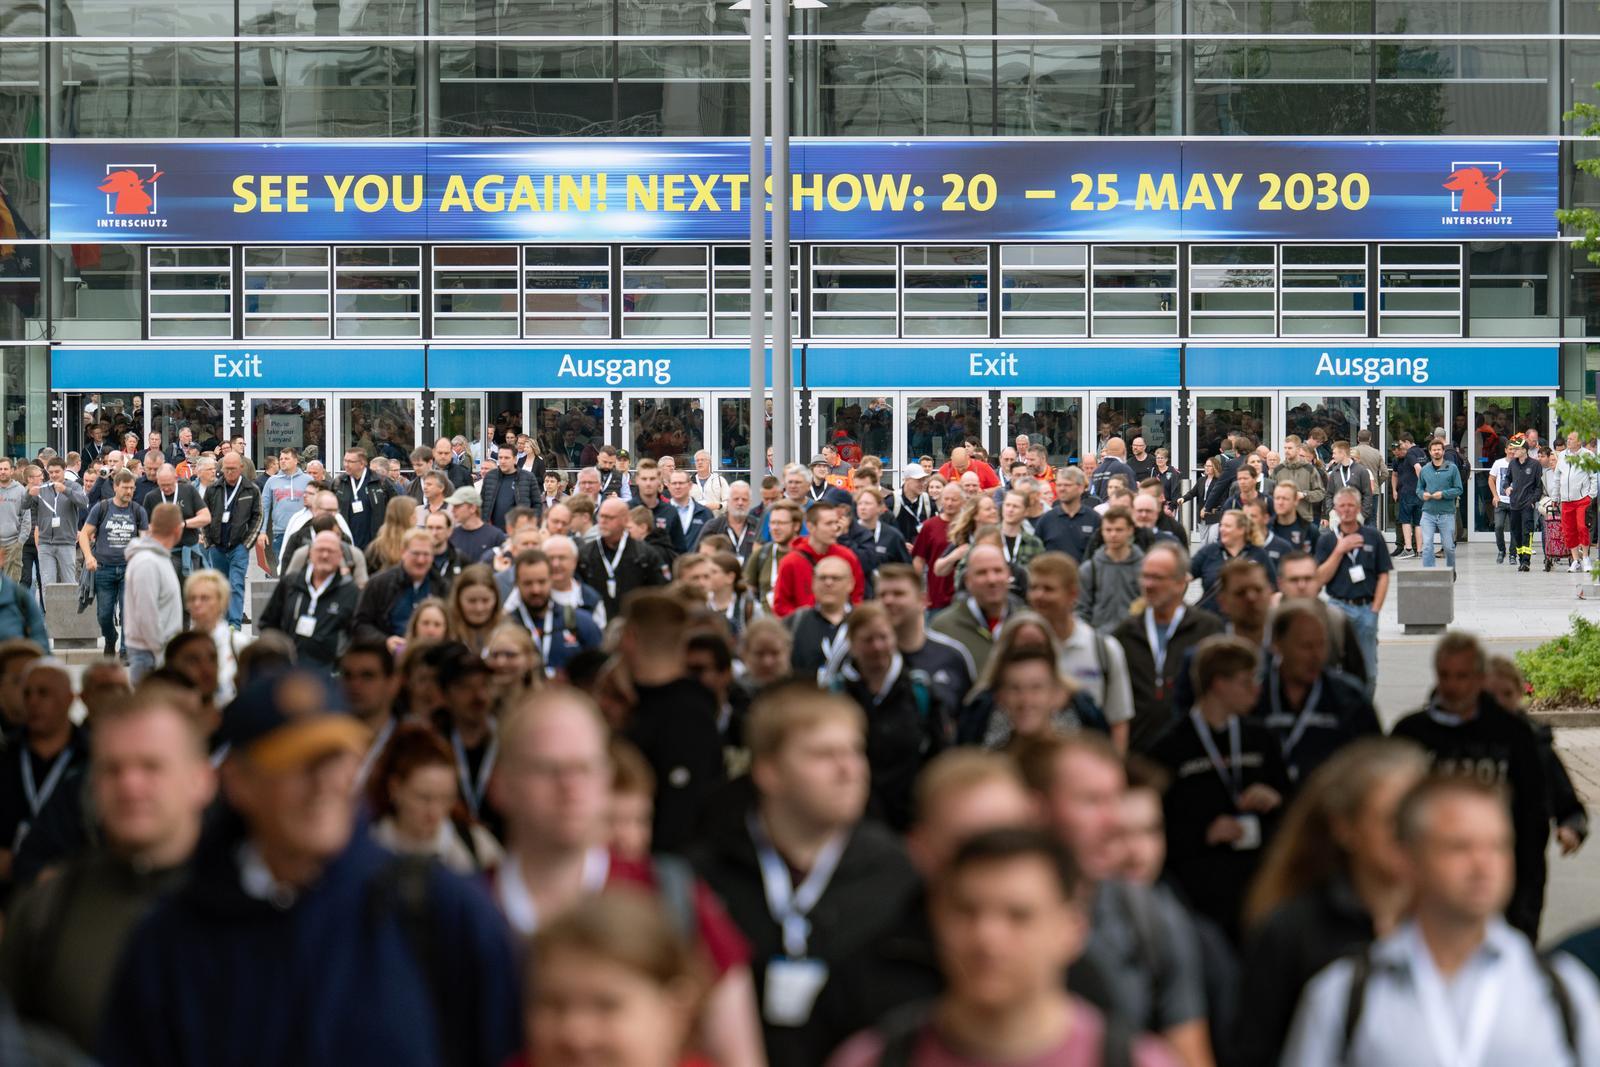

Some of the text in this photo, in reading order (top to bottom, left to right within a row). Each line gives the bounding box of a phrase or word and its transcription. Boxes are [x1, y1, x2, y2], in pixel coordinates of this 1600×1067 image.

[232, 174, 309, 213] SEE
[325, 174, 423, 213] YOU
[439, 173, 607, 213] AGAIN!
[626, 174, 749, 212] NEXT
[942, 173, 998, 212] 20
[1070, 173, 1119, 211] 25
[1135, 172, 1244, 211] MAY
[1258, 172, 1370, 211] 2030
[97, 219, 168, 228] INTERSCHUTZ
[1441, 216, 1513, 225] INTERSCHUTZ
[213, 353, 263, 378] Exit
[557, 353, 672, 385] Ausgang
[969, 351, 1019, 376] Exit
[1315, 352, 1429, 384] Ausgang
